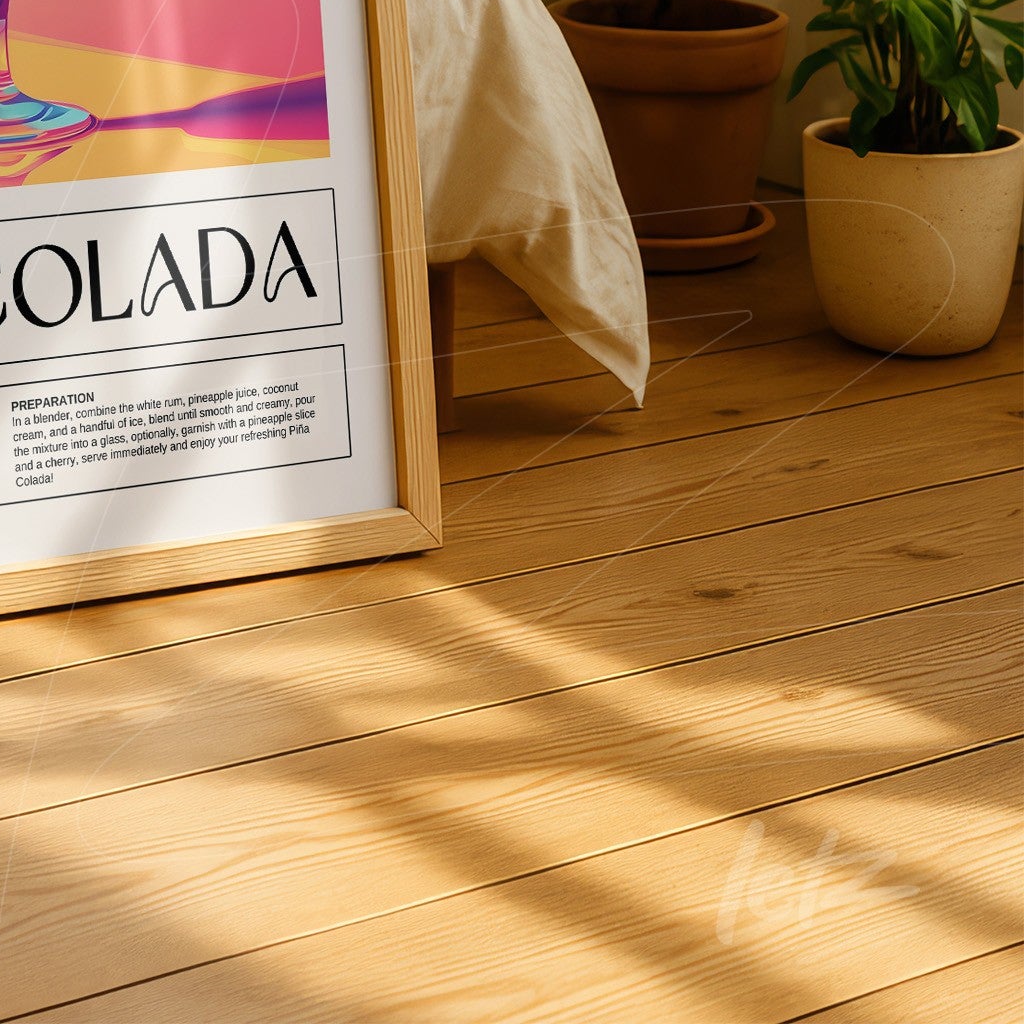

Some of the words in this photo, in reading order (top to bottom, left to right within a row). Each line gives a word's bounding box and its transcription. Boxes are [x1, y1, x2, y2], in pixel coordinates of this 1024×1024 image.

[11, 391, 95, 412] PREPARATION
[12, 416, 22, 427] In
[24, 416, 31, 426] a
[33, 410, 73, 425] blender,
[75, 405, 117, 419] combine
[118, 403, 135, 414] the
[136, 398, 162, 411] white
[164, 397, 186, 408] rum,
[188, 389, 234, 408] pineapple
[235, 387, 260, 402] juice,
[262, 381, 299, 395] coconut
[12, 430, 47, 442] cream,
[49, 424, 68, 438] and
[70, 426, 78, 435] a
[79, 419, 115, 434] handful
[117, 417, 127, 429] of
[129, 416, 146, 427] ice,
[148, 411, 175, 425] blend
[177, 408, 197, 421] until
[199, 404, 234, 418] smooth
[236, 400, 254, 414] and
[295, 395, 316, 408] pour
[13, 446, 30, 457] the
[32, 442, 69, 455] mixture
[70, 439, 89, 450] into
[91, 438, 98, 447] a
[99, 434, 129, 449] glass,
[130, 426, 179, 444] optionally,
[181, 421, 216, 438] garnish
[217, 418, 238, 430] with
[239, 419, 246, 428] a
[248, 411, 293, 429] pineapple
[294, 408, 316, 421] slice
[14, 459, 34, 473] and
[36, 461, 43, 470] a
[45, 456, 79, 469] cherry,
[81, 452, 108, 464] serve
[110, 442, 168, 460] immediately
[169, 439, 188, 452] and
[190, 437, 216, 450] enjoy
[217, 434, 239, 448] your
[240, 427, 287, 442] refreshing
[288, 423, 311, 436] Piña
[15, 472, 54, 488] Colada!
